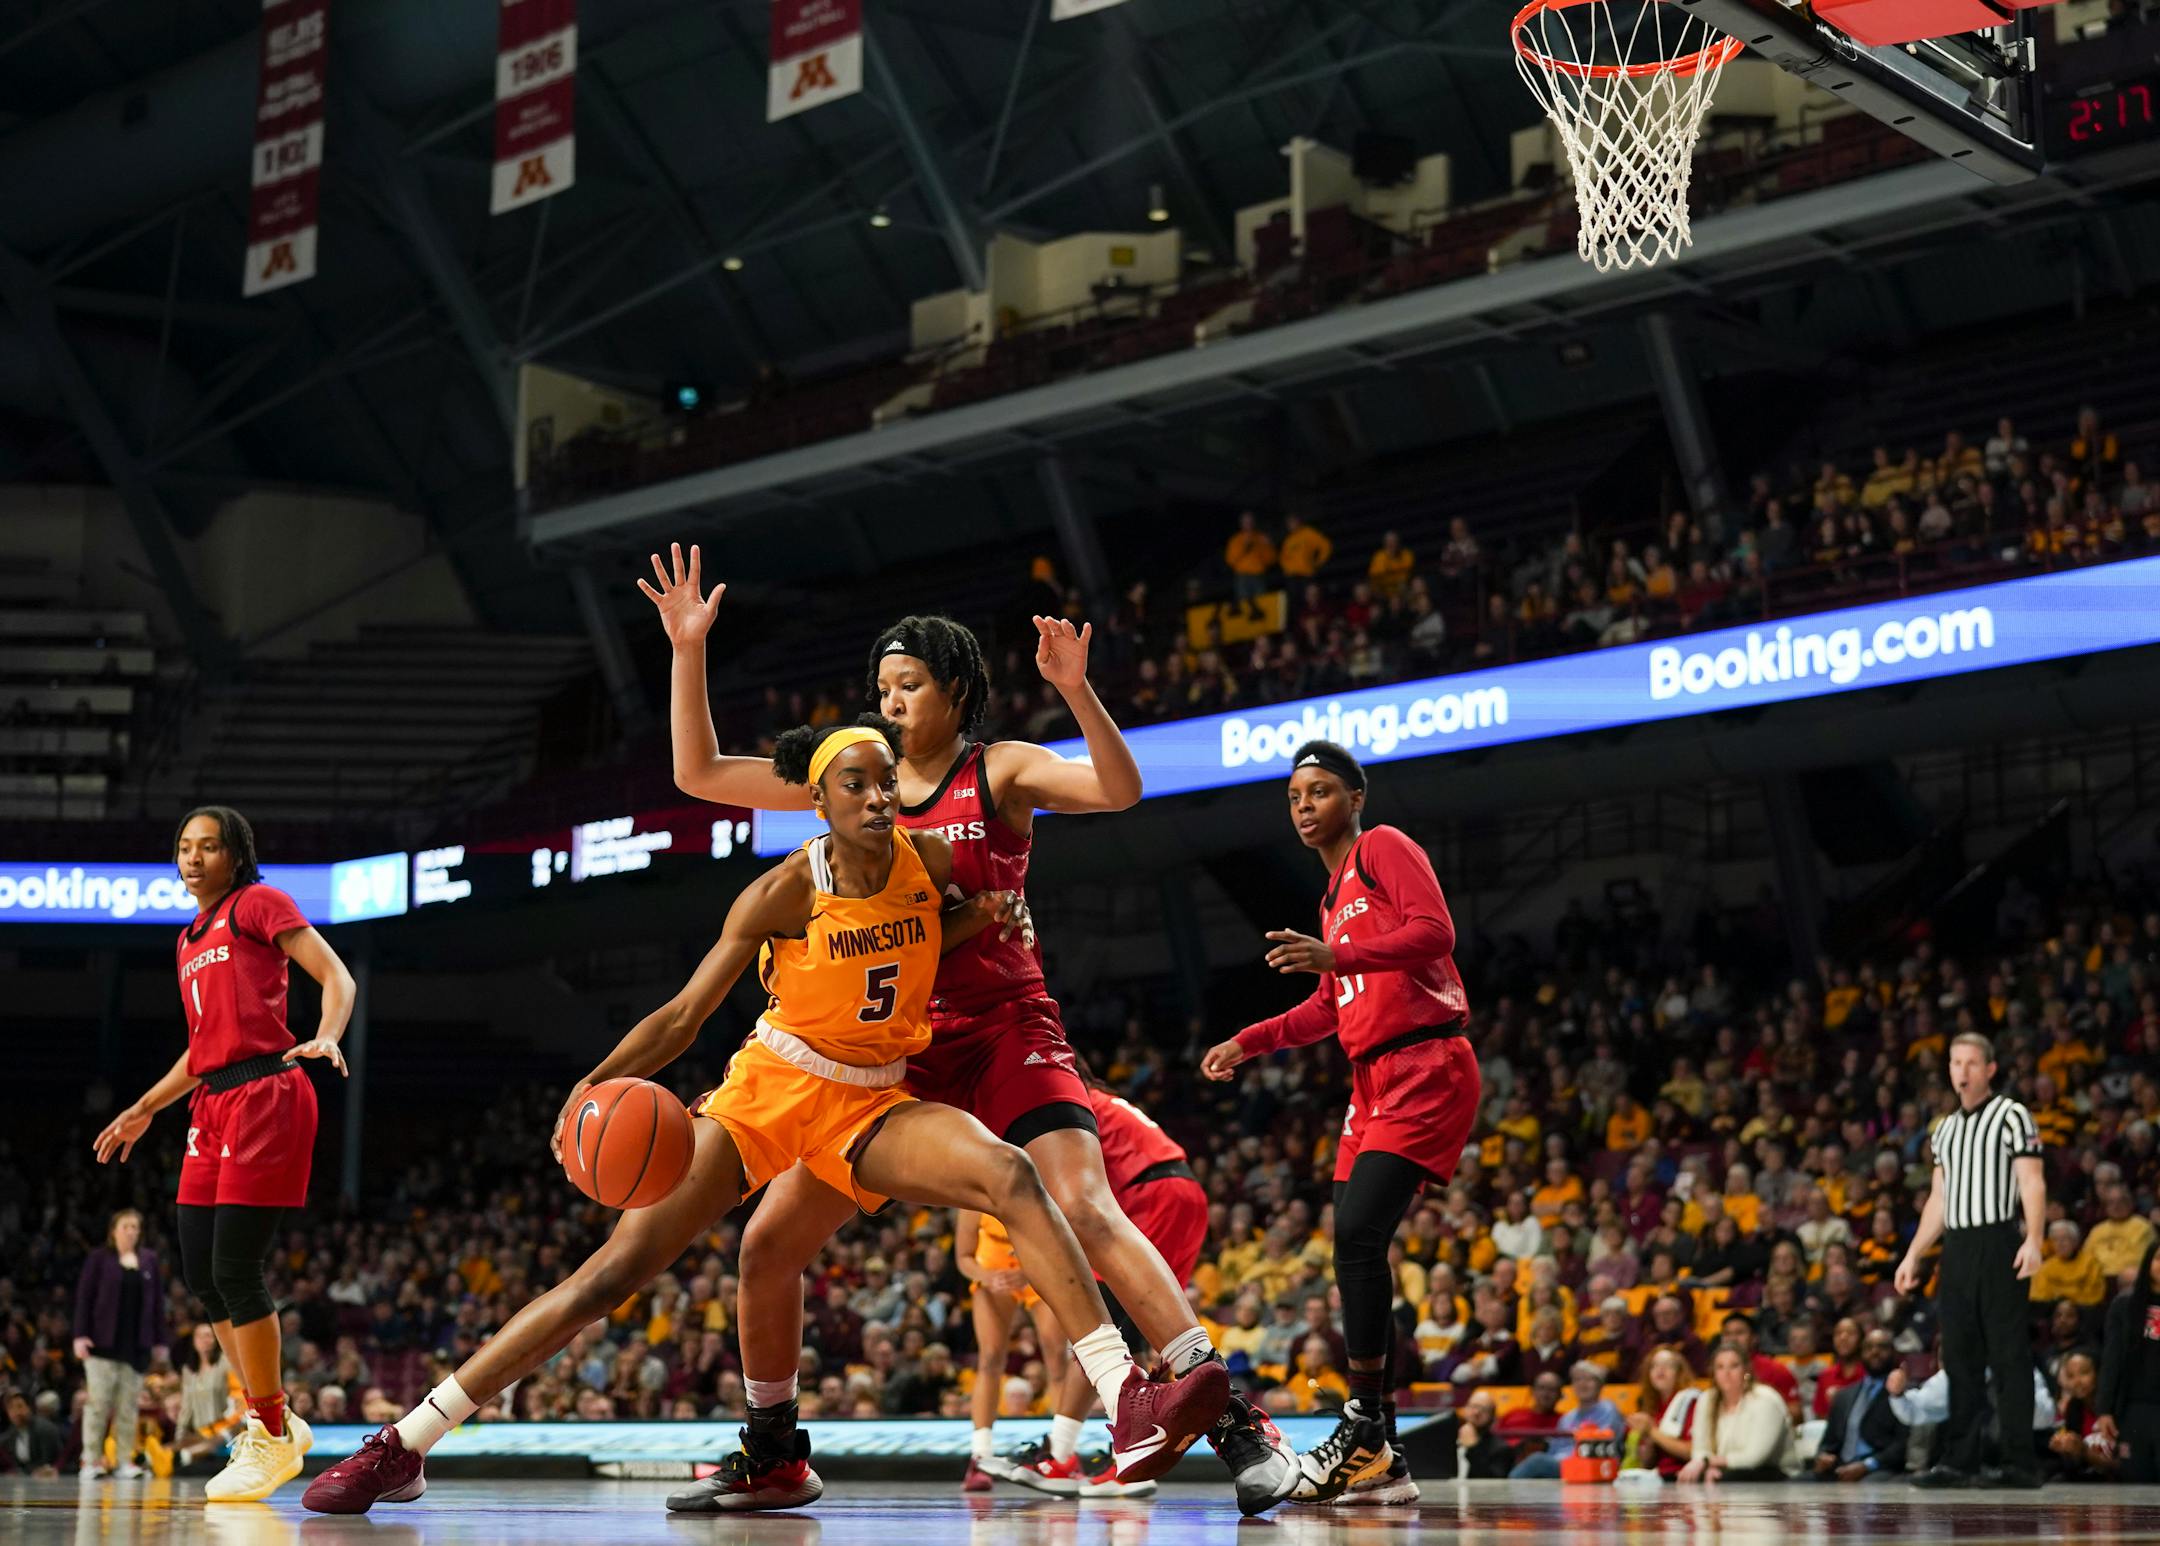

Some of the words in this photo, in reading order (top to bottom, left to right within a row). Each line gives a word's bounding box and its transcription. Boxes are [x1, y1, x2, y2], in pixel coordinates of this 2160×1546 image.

[2065, 85, 2151, 142] 2:17
[1651, 607, 1994, 699] Booking.com
[1222, 686, 1509, 767] Booking.com
[0, 867, 196, 918] ooking.co
[828, 916, 926, 961] MINNESOTA
[855, 960, 901, 1024] 5
